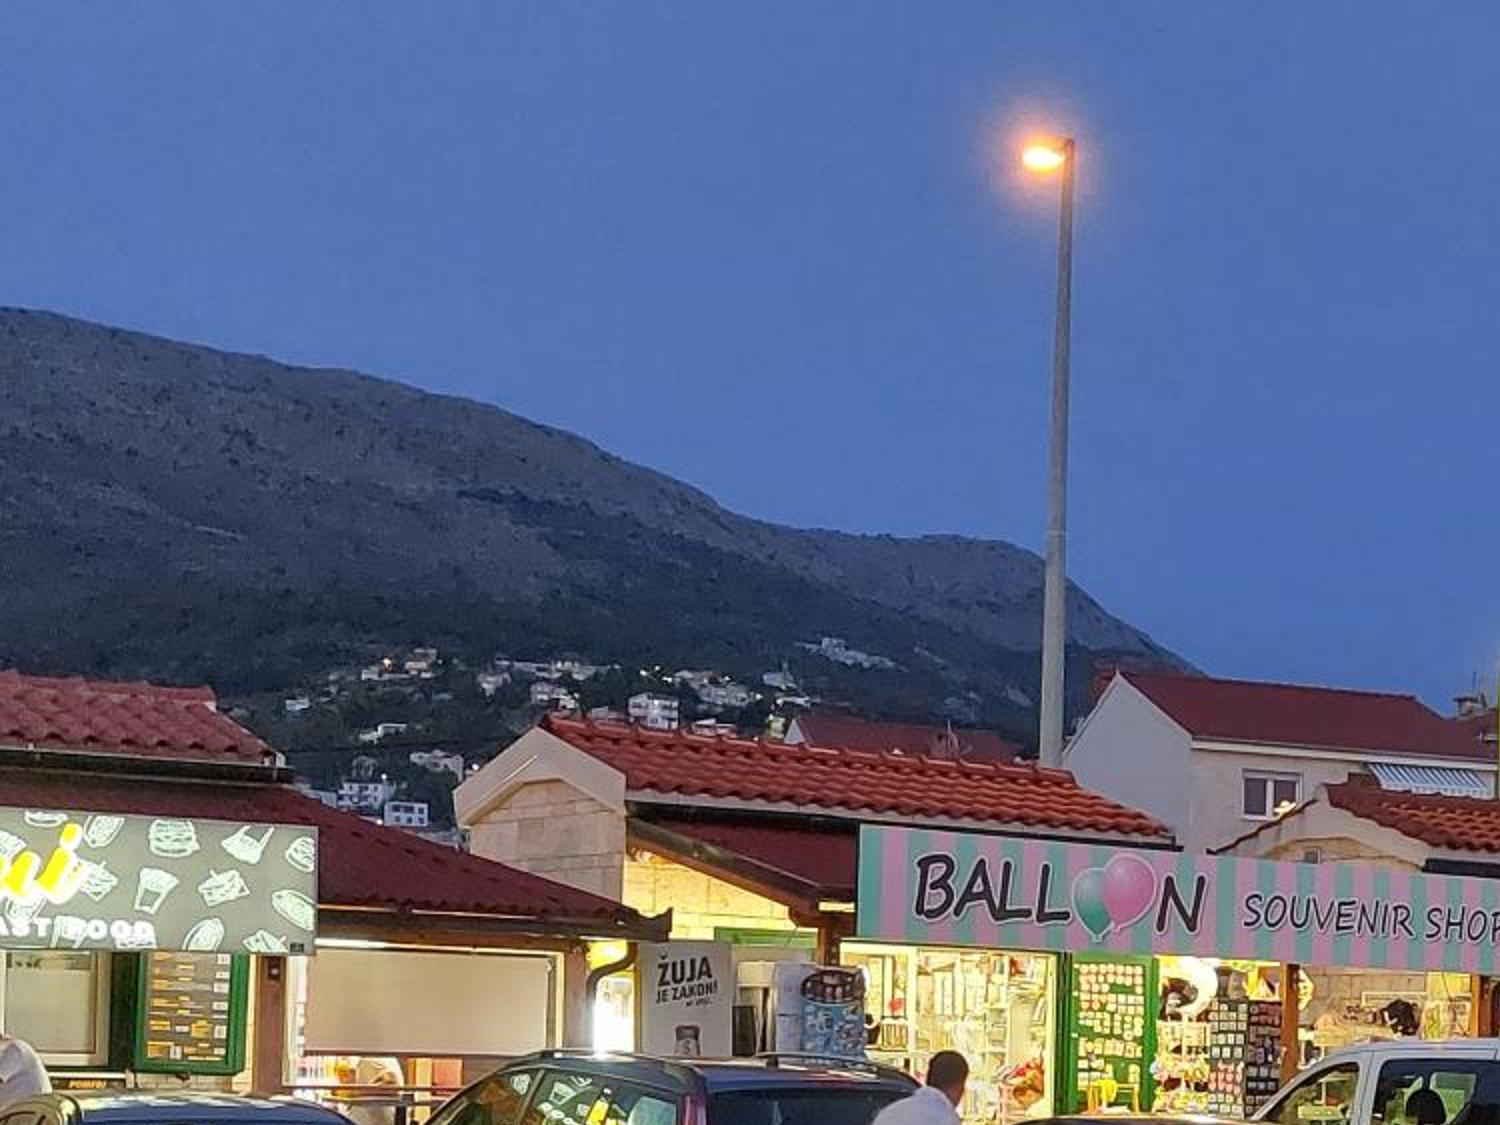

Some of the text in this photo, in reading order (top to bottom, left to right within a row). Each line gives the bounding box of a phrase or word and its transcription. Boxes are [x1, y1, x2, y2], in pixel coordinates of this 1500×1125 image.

[1243, 892, 1415, 938] SOUVENIR
[657, 951, 713, 987] ŽUJA
[656, 989, 669, 1004] JE
[671, 979, 718, 1002] ZAKON!
